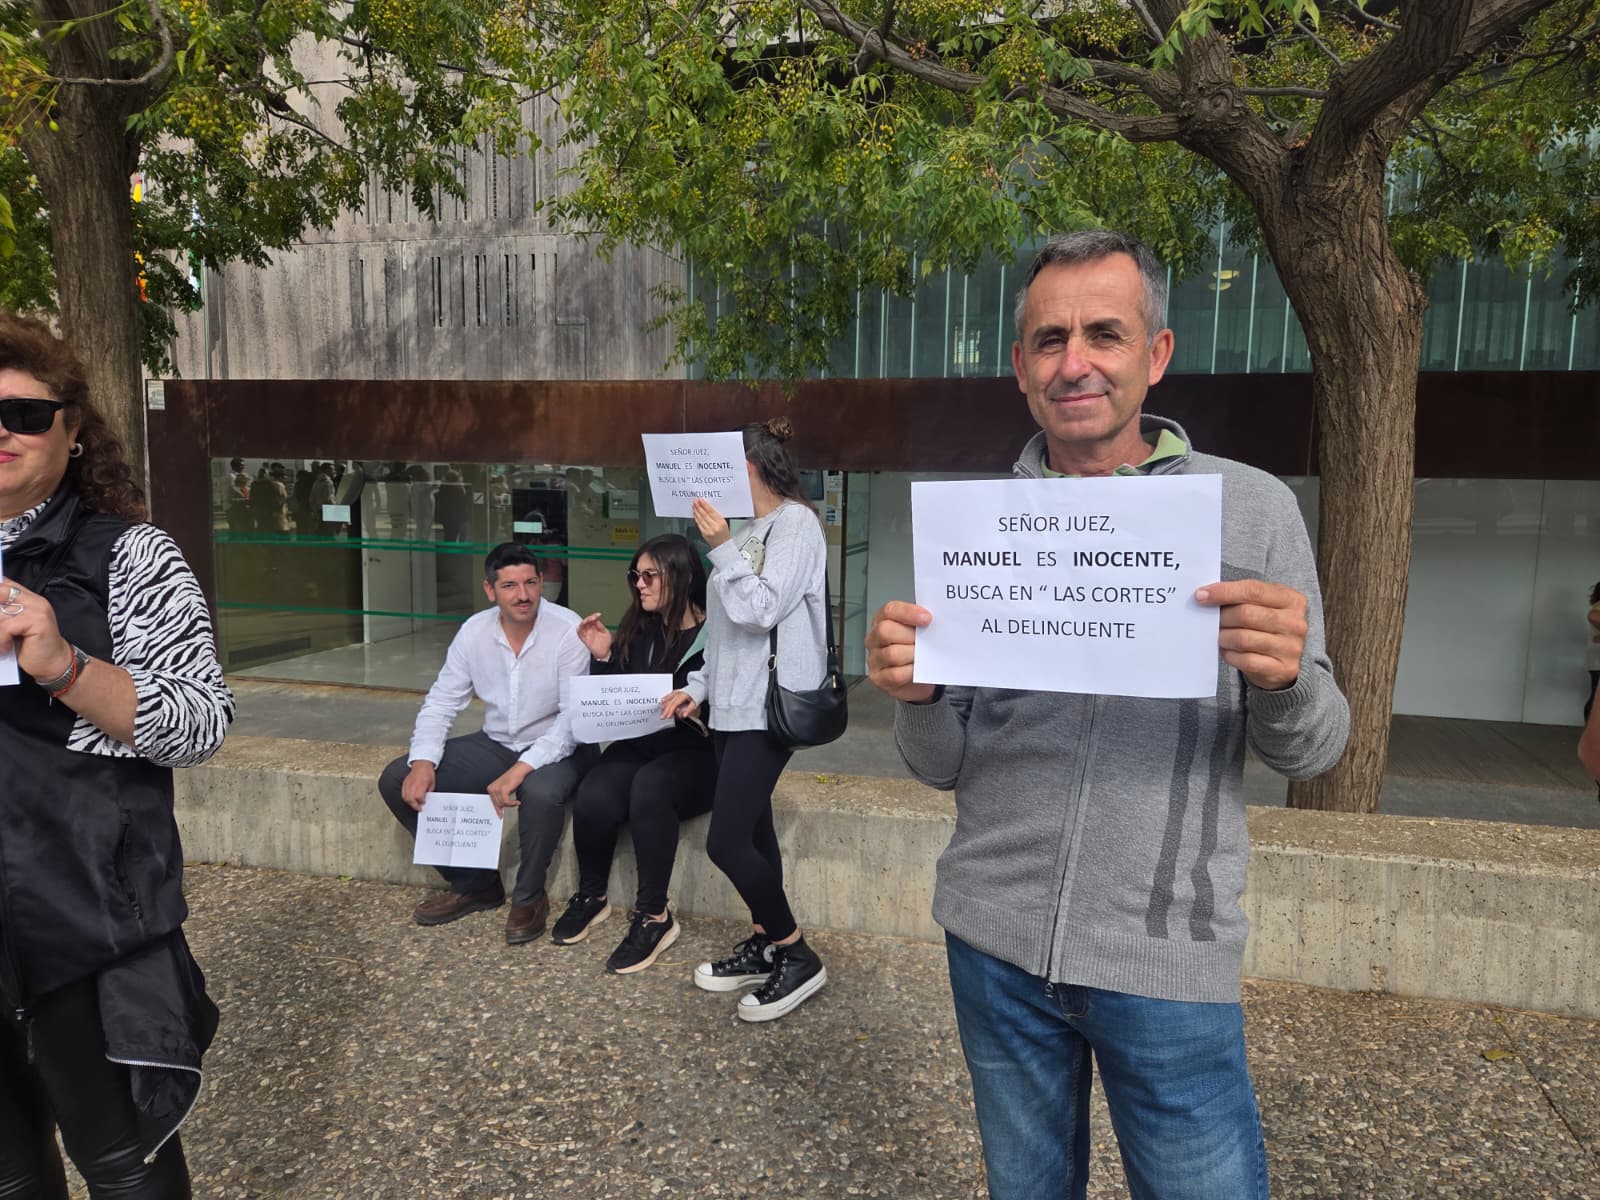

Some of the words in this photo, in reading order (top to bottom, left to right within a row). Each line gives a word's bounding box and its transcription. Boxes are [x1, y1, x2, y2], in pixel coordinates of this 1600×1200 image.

[999, 514, 1060, 532] SEÑOR
[1066, 516, 1116, 534] JUEZ,
[943, 552, 1021, 566] MANUEL
[1037, 552, 1056, 566] ES
[1073, 552, 1180, 570] INOCENTE,
[946, 584, 1003, 600] BUSCA
[1010, 586, 1032, 600] EN
[1091, 587, 1176, 604] CORTES”
[981, 619, 1002, 634] AL
[1008, 619, 1136, 638] DELINCUENTE
